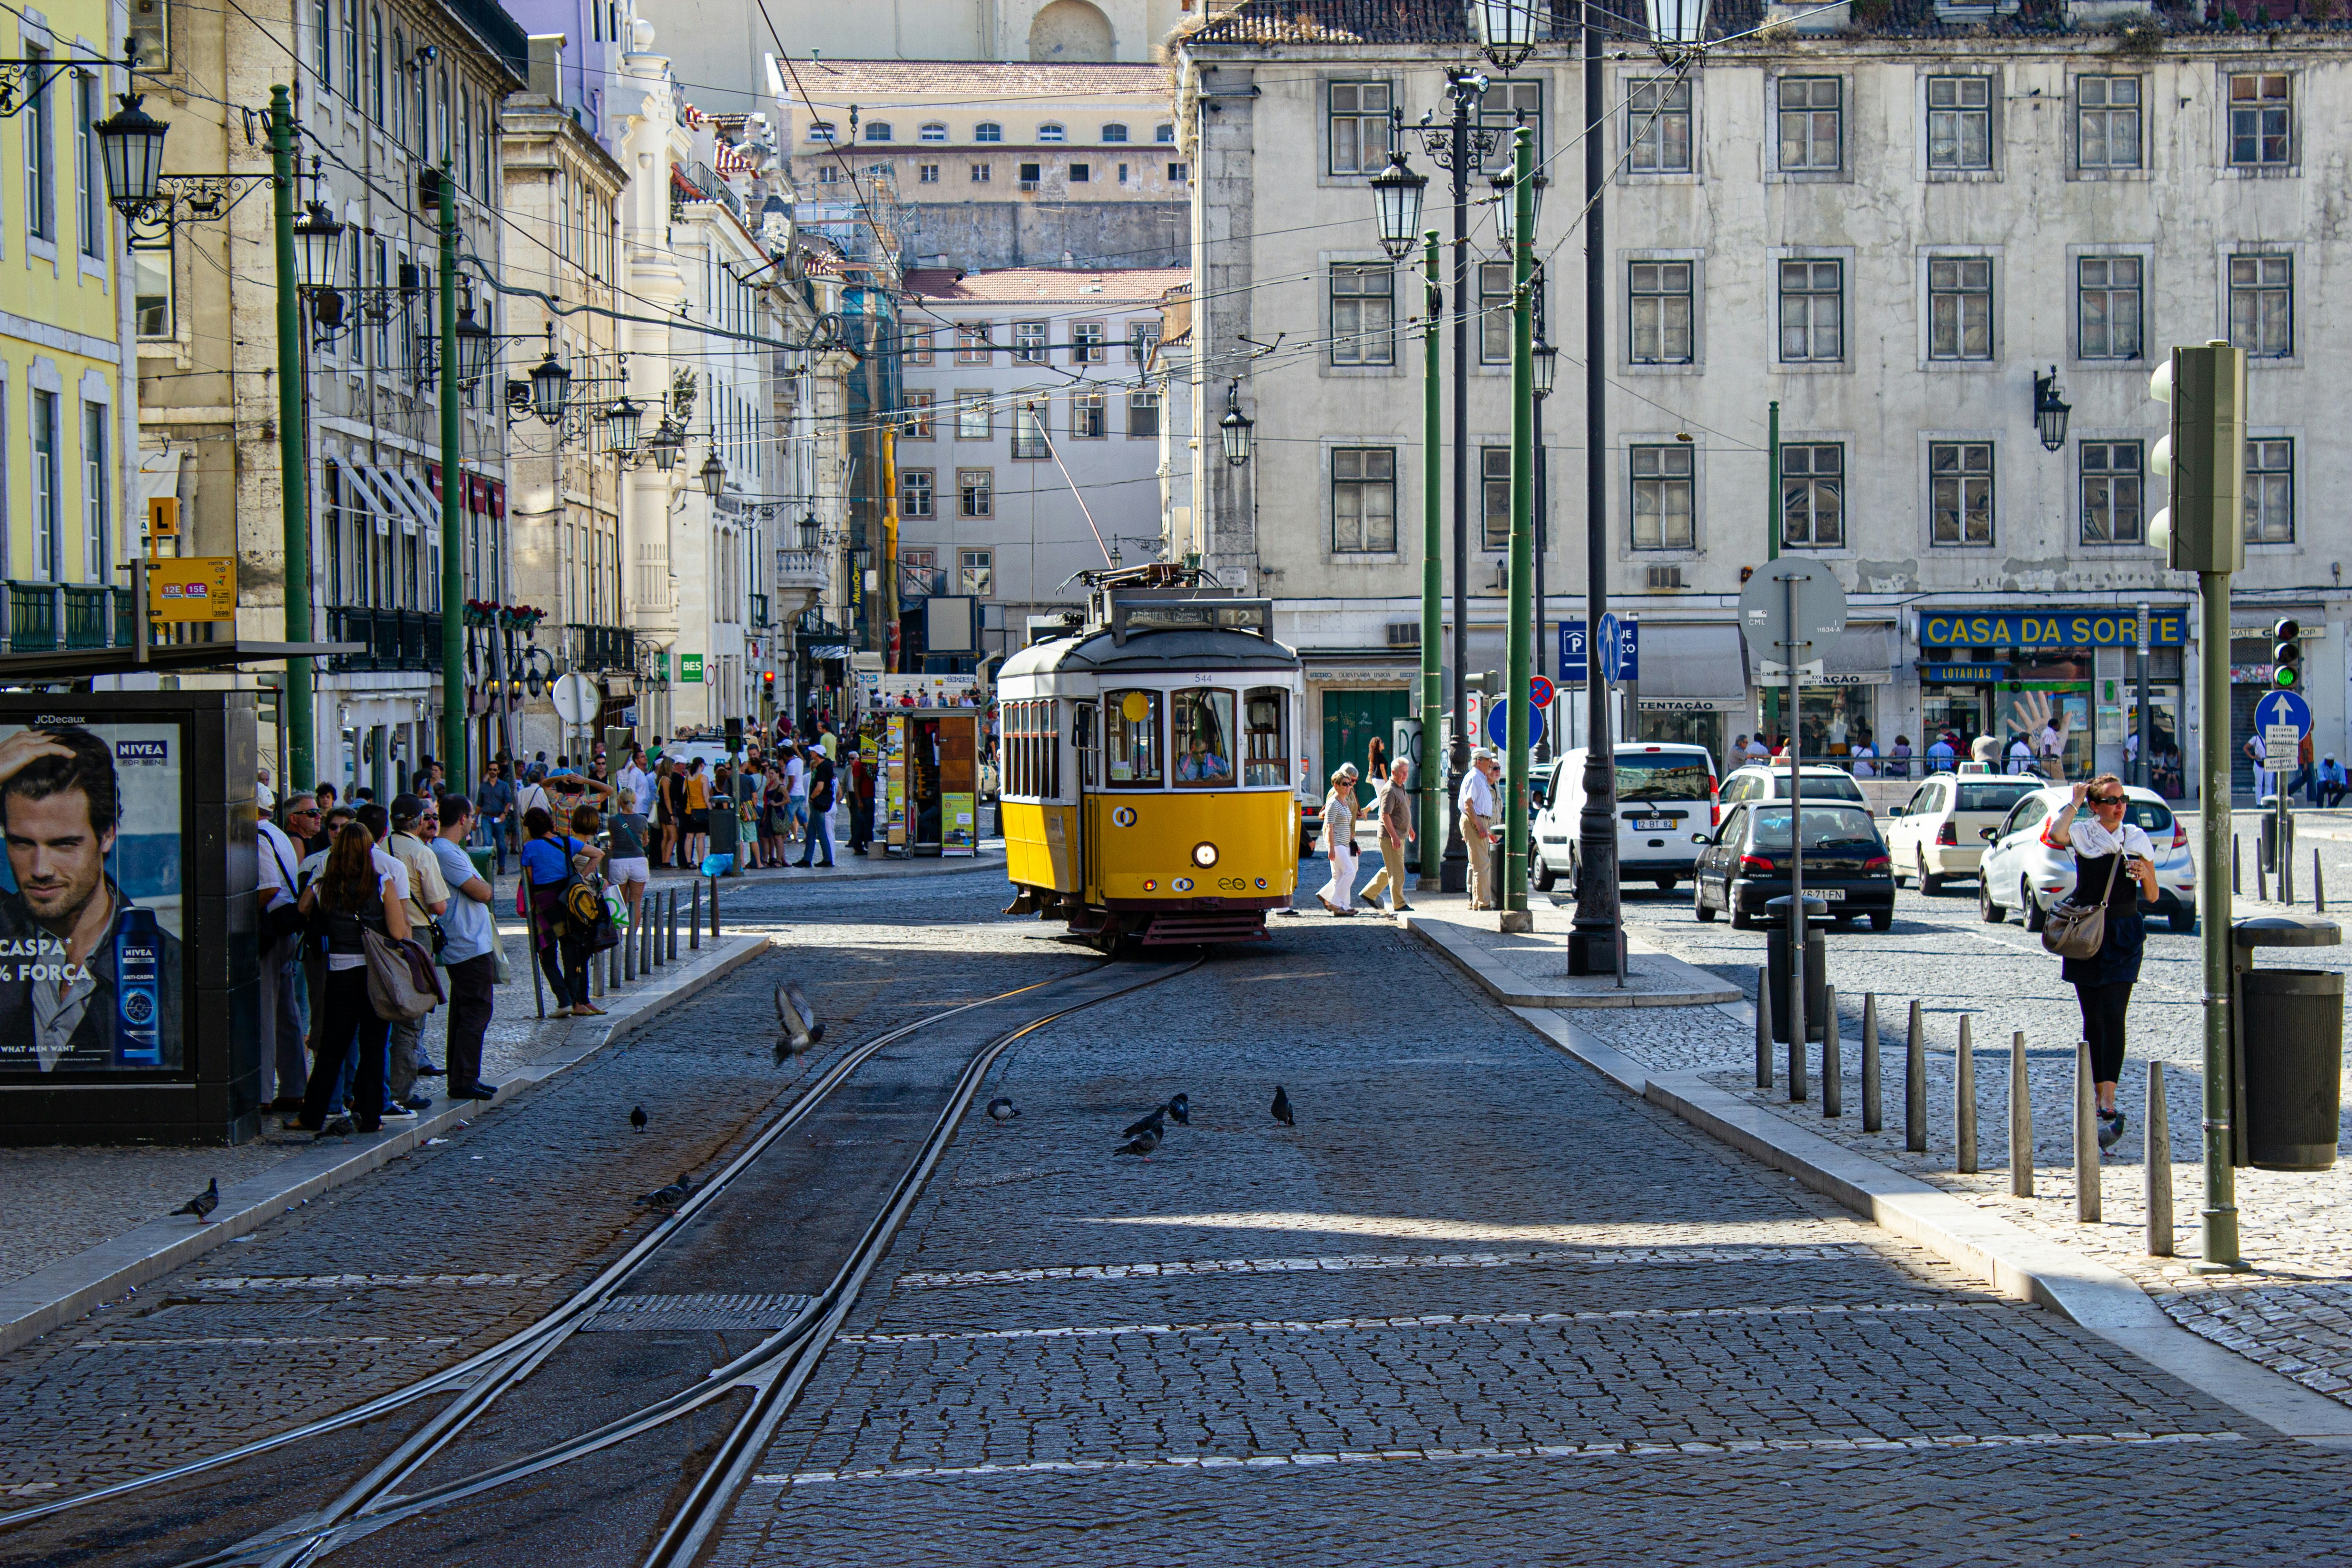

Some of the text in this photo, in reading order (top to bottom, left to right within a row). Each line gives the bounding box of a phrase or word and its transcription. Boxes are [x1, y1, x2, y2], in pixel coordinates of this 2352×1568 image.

[156, 506, 168, 529] L
[1228, 610, 1249, 625] 12
[1927, 618, 2011, 643] CASA
[2021, 618, 2062, 642] DA
[1572, 637, 1582, 653] P
[683, 661, 702, 671] BES
[1194, 674, 1212, 683] 544
[1942, 668, 1991, 679] LOTARIAS
[1823, 675, 1860, 684] AÇÃO
[1638, 701, 1714, 711] TENTAÇÃO
[34, 715, 86, 724] JCDecaux
[120, 744, 164, 755] NIVEA
[18, 963, 92, 986] FORÇA
